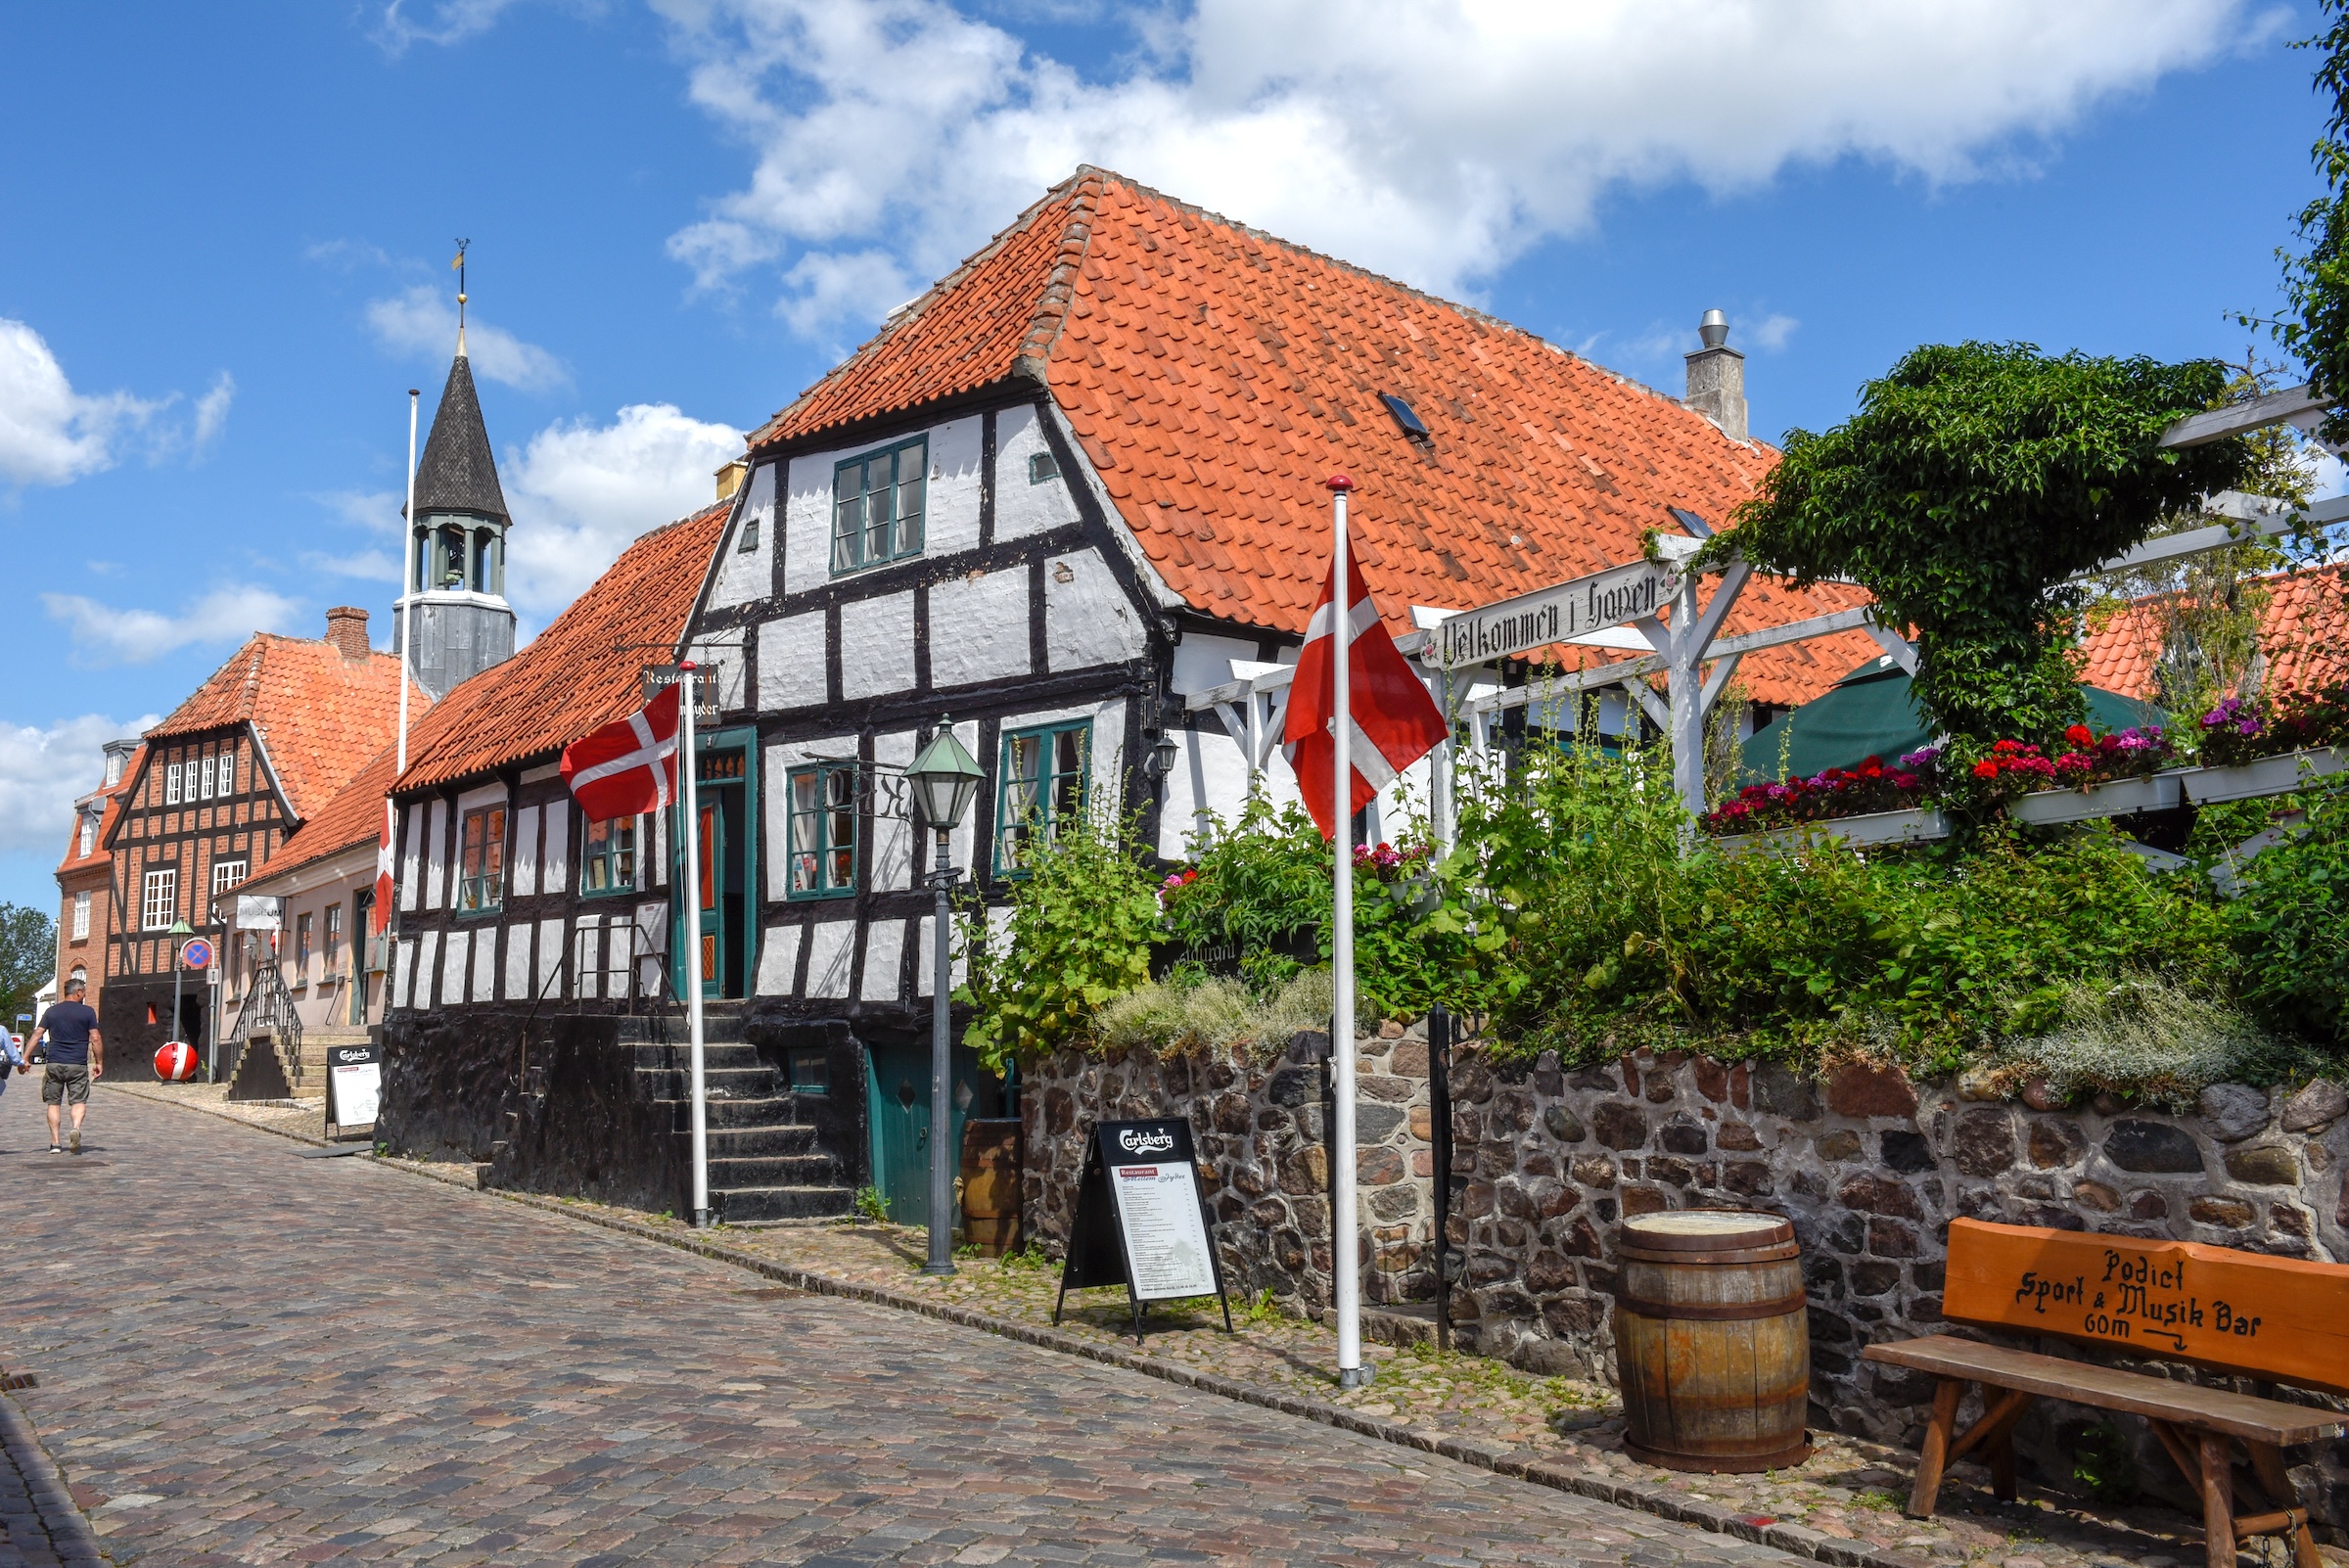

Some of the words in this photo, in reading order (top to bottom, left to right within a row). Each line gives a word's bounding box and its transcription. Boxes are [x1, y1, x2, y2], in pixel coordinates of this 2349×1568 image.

[1444, 603, 1559, 667] Velkommen
[1569, 594, 1576, 634] i
[1585, 576, 1657, 629] Haven
[239, 907, 282, 917] MUSEUM
[340, 1048, 370, 1062] Carlsberg
[1120, 1129, 1174, 1155] Carlsberg
[2015, 1271, 2085, 1314] Sport
[2093, 1291, 2105, 1309] &
[2116, 1282, 2204, 1328] Musik
[2212, 1300, 2263, 1338] Bar
